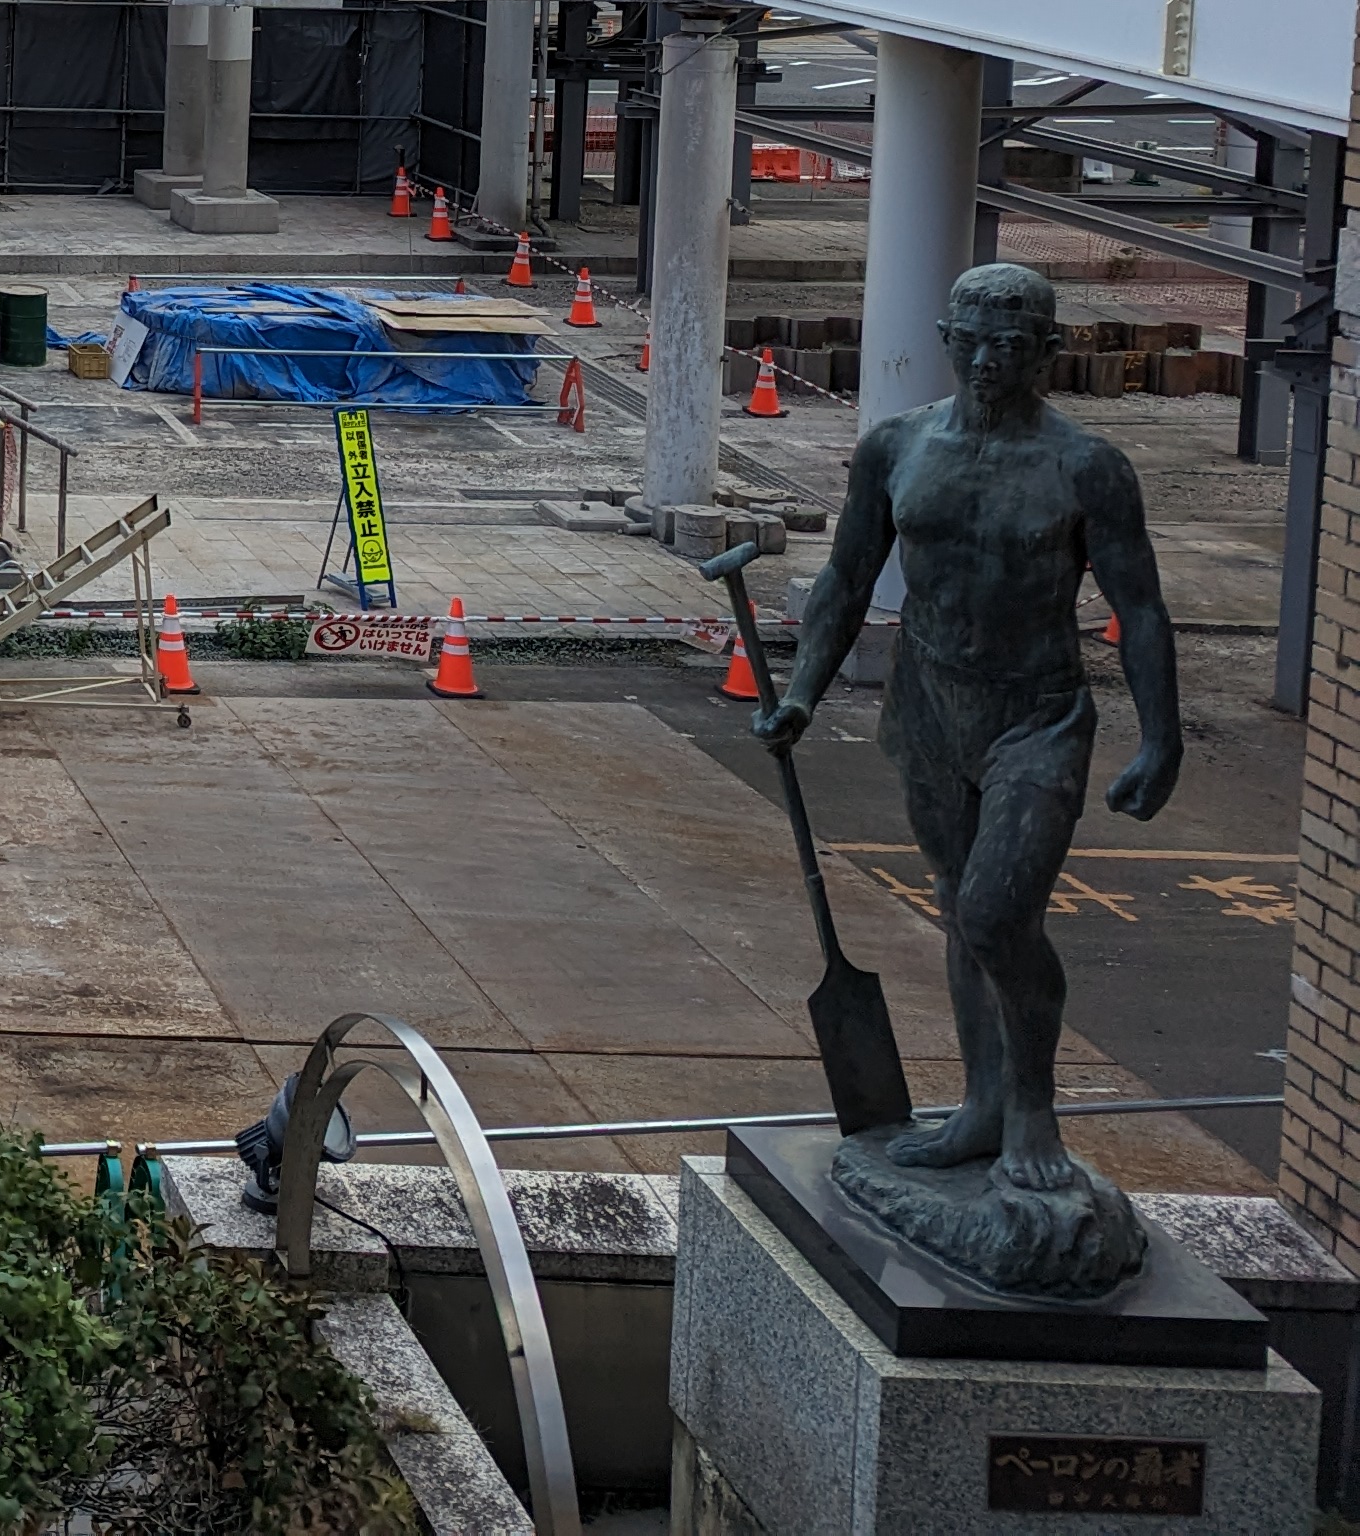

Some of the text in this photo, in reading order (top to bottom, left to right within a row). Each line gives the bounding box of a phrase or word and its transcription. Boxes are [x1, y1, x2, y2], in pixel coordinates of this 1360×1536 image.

[346, 431, 357, 461] 以外
[356, 430, 368, 460] 関係者
[351, 462, 380, 538] 立入禁止
[360, 639, 426, 656] いけません
[363, 629, 430, 643] はいっては
